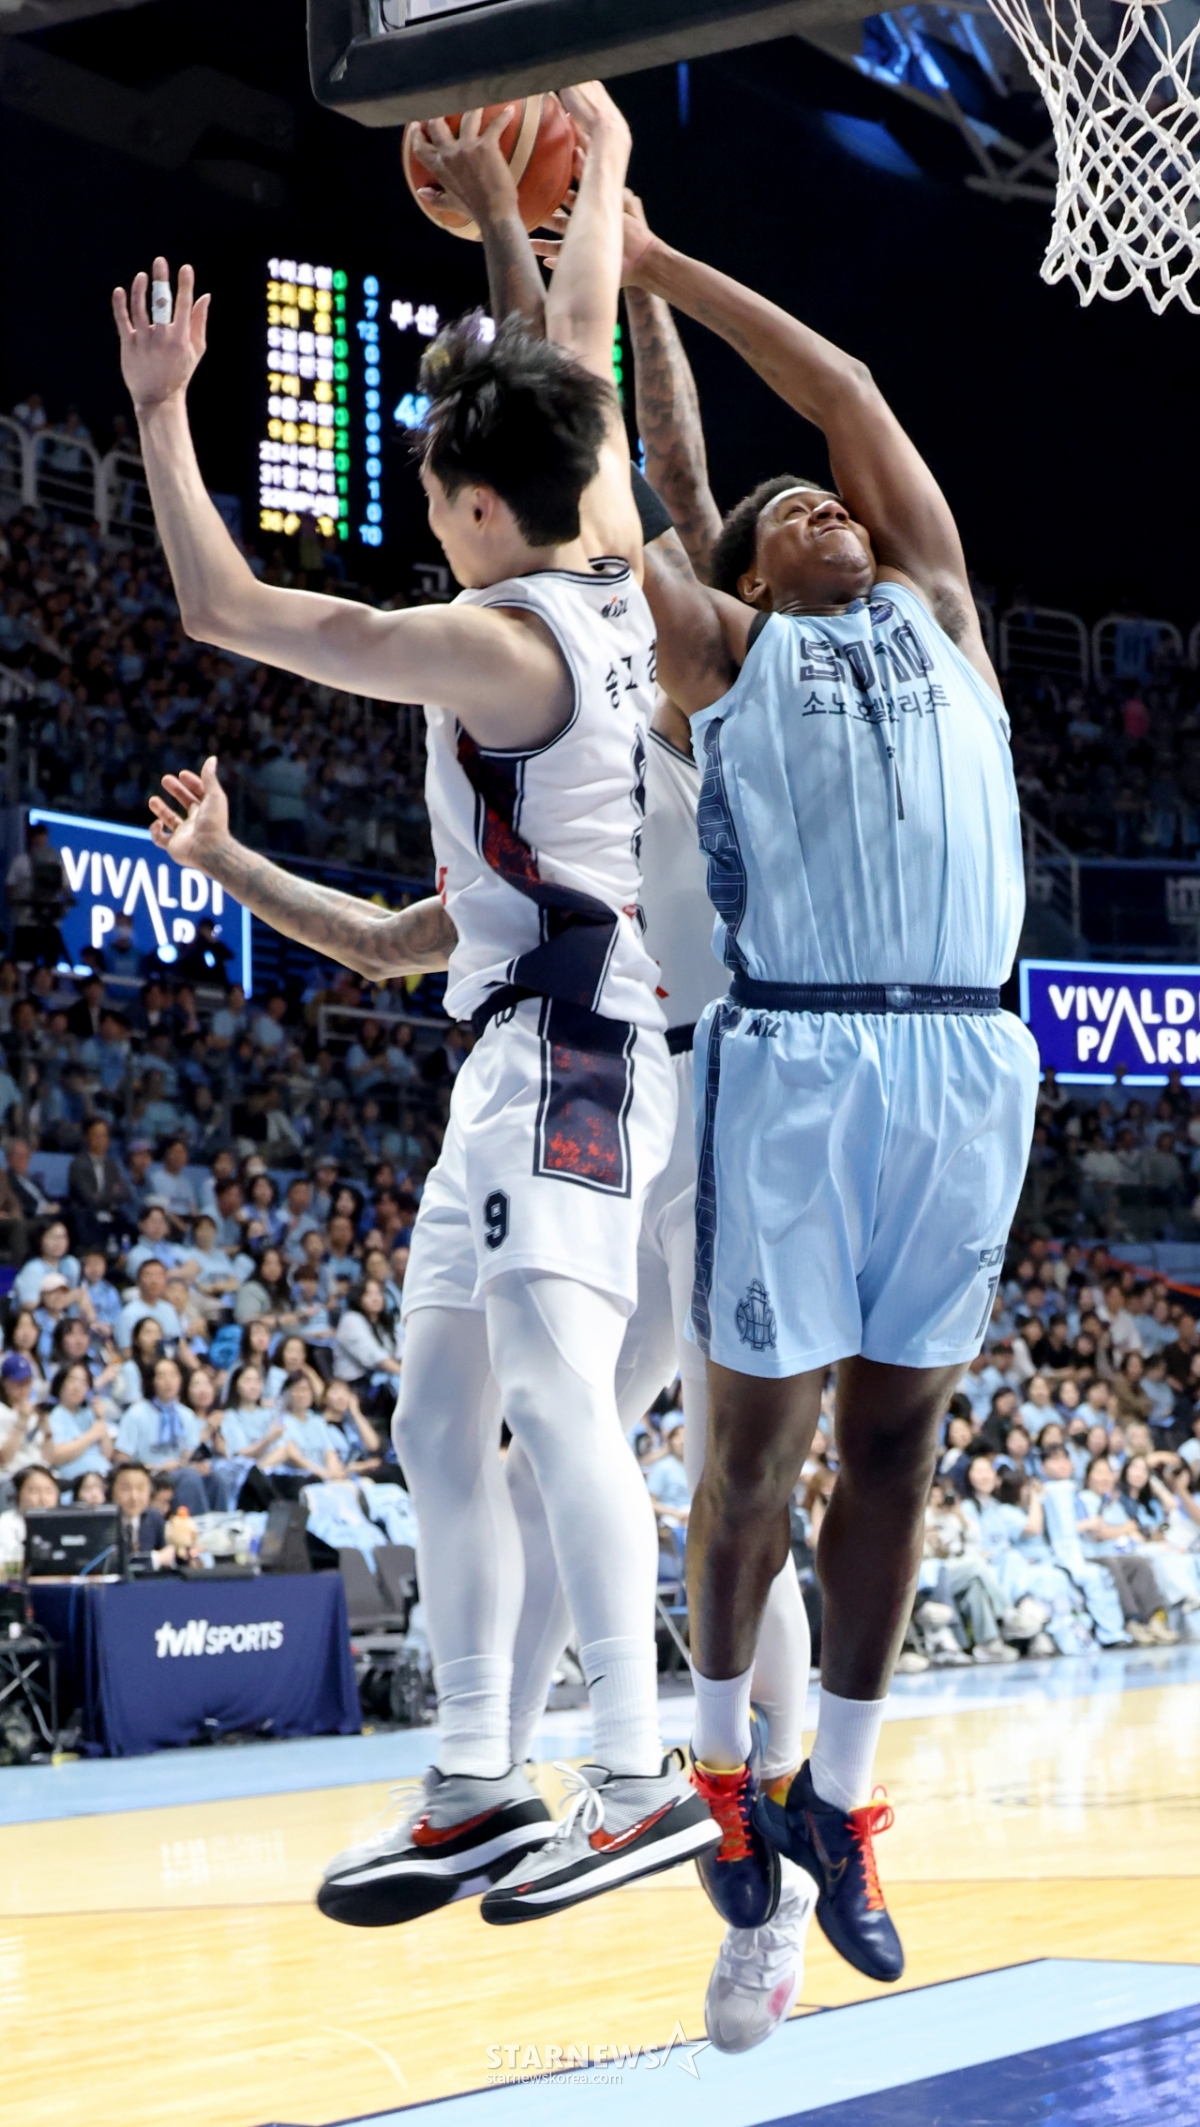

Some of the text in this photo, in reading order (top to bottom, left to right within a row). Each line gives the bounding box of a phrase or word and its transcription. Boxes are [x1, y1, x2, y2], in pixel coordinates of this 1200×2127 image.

[364, 298, 379, 319] 7
[60, 846, 224, 916] VIVALDI
[1048, 984, 1200, 1025] VIVALD
[483, 1188, 511, 1252] 9
